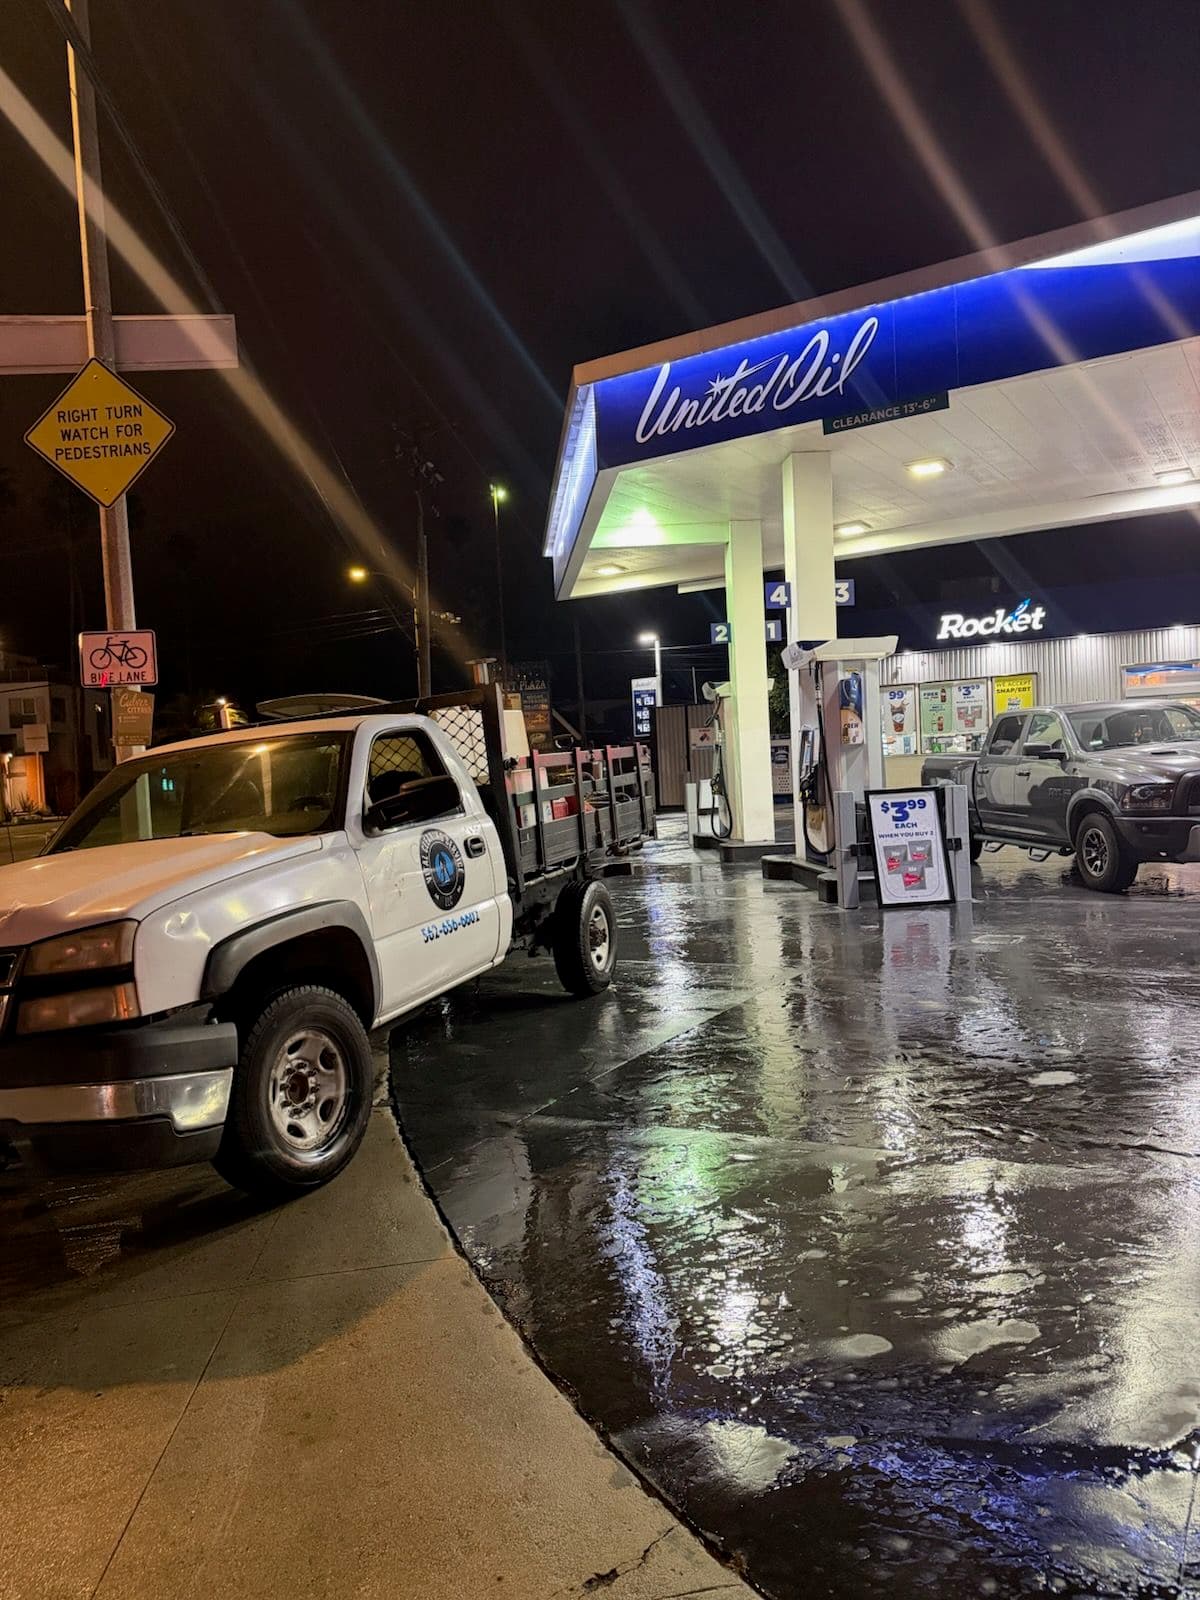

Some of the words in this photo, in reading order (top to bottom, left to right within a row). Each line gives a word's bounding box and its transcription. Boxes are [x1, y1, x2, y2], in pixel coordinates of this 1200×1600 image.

[635, 354, 788, 443] United
[773, 317, 879, 411] Oil
[57, 408, 98, 423] RIGHT
[105, 404, 142, 420] TURN
[832, 406, 900, 430] CLEARANCE
[61, 426, 109, 441] WATCH
[116, 423, 143, 438] FOR
[55, 442, 151, 461] PEDESTRIANS
[769, 585, 789, 606] 4
[835, 582, 850, 603] 3
[766, 622, 776, 639] 1
[936, 606, 1046, 640] Rocket
[714, 625, 729, 642] 2
[119, 671, 147, 682] LANE
